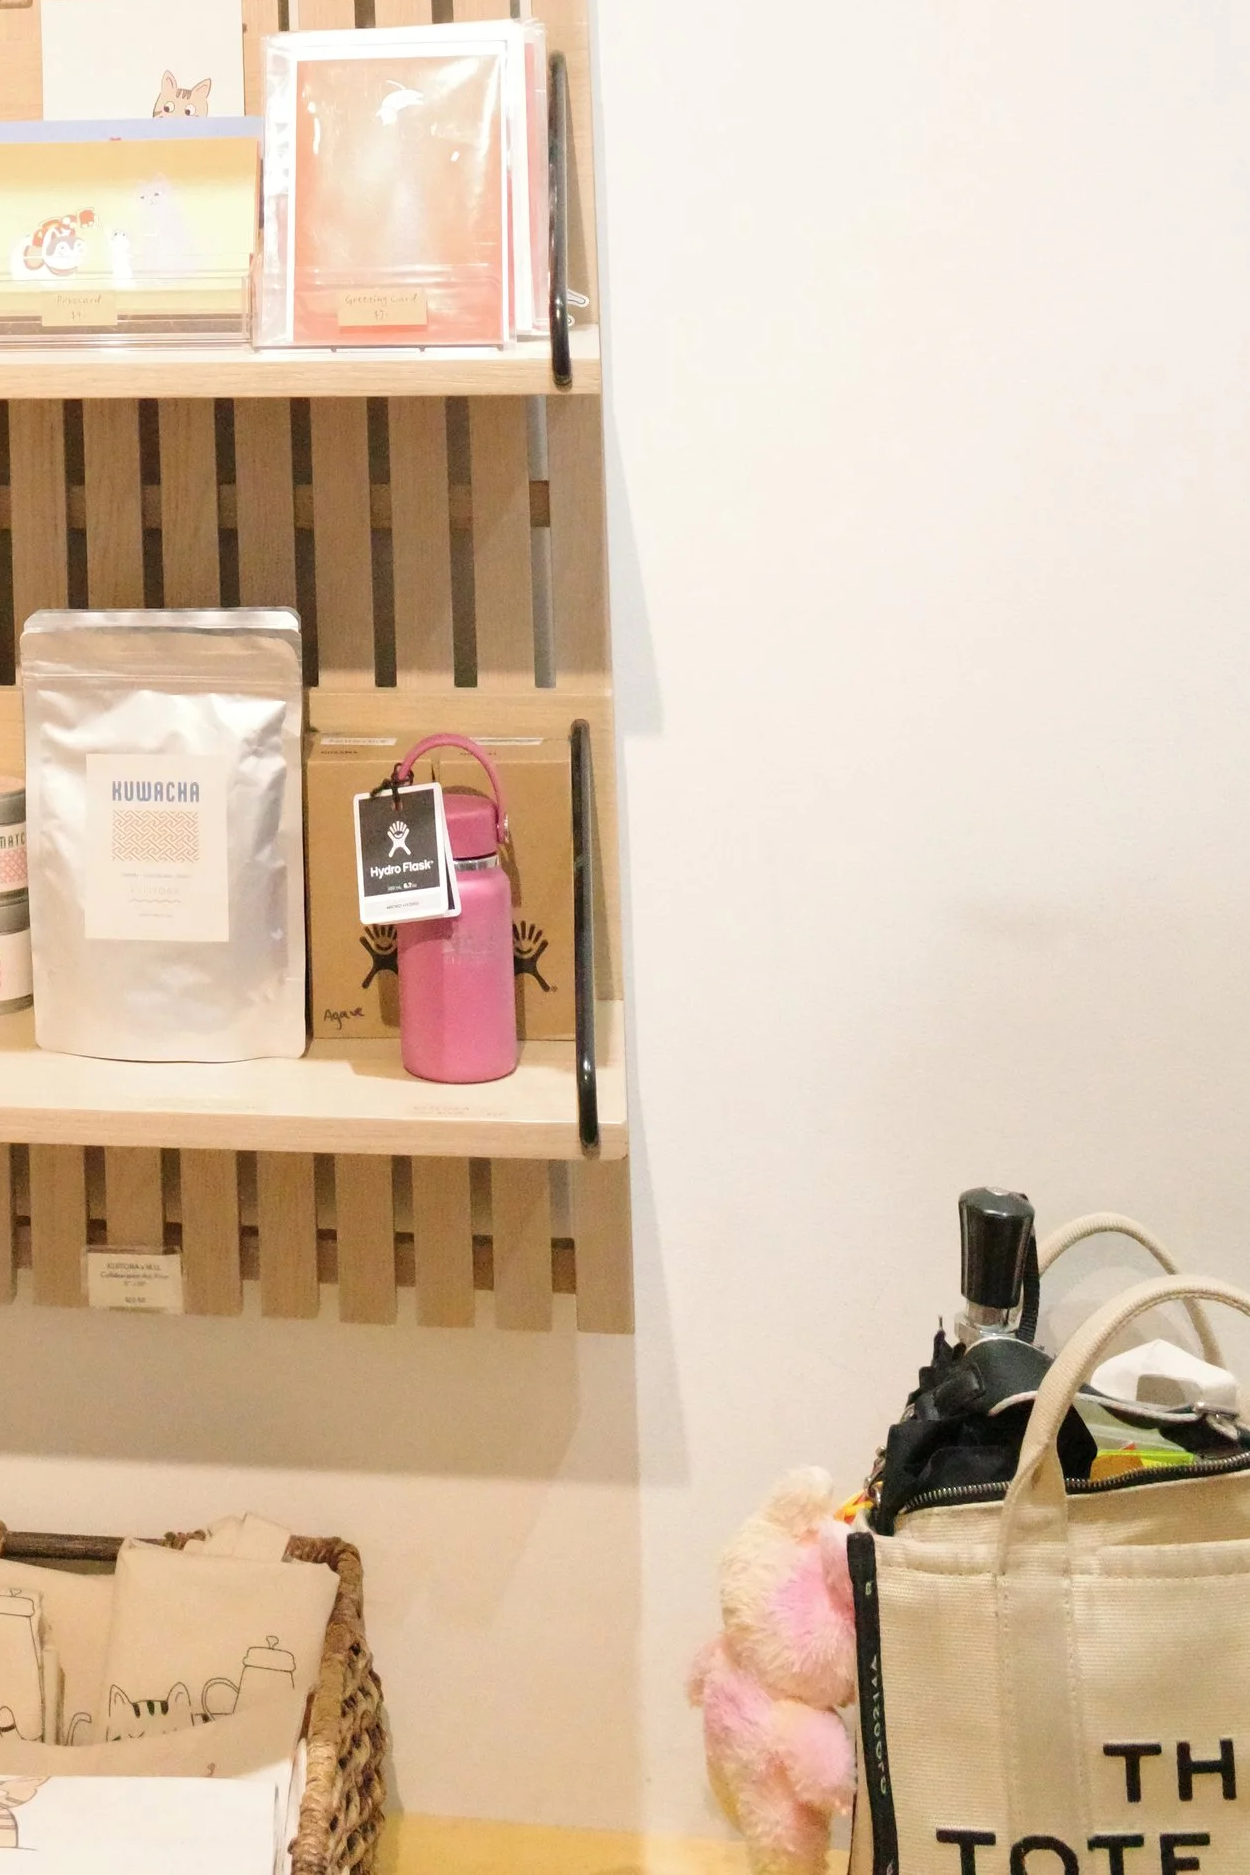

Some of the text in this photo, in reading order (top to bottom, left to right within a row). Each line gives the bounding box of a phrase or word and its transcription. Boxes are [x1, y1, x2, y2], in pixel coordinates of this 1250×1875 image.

[345, 294, 387, 306] Greeting
[112, 781, 200, 802] KUWACHA
[370, 859, 431, 879] Hydro Flask
[323, 1006, 365, 1030] Agave
